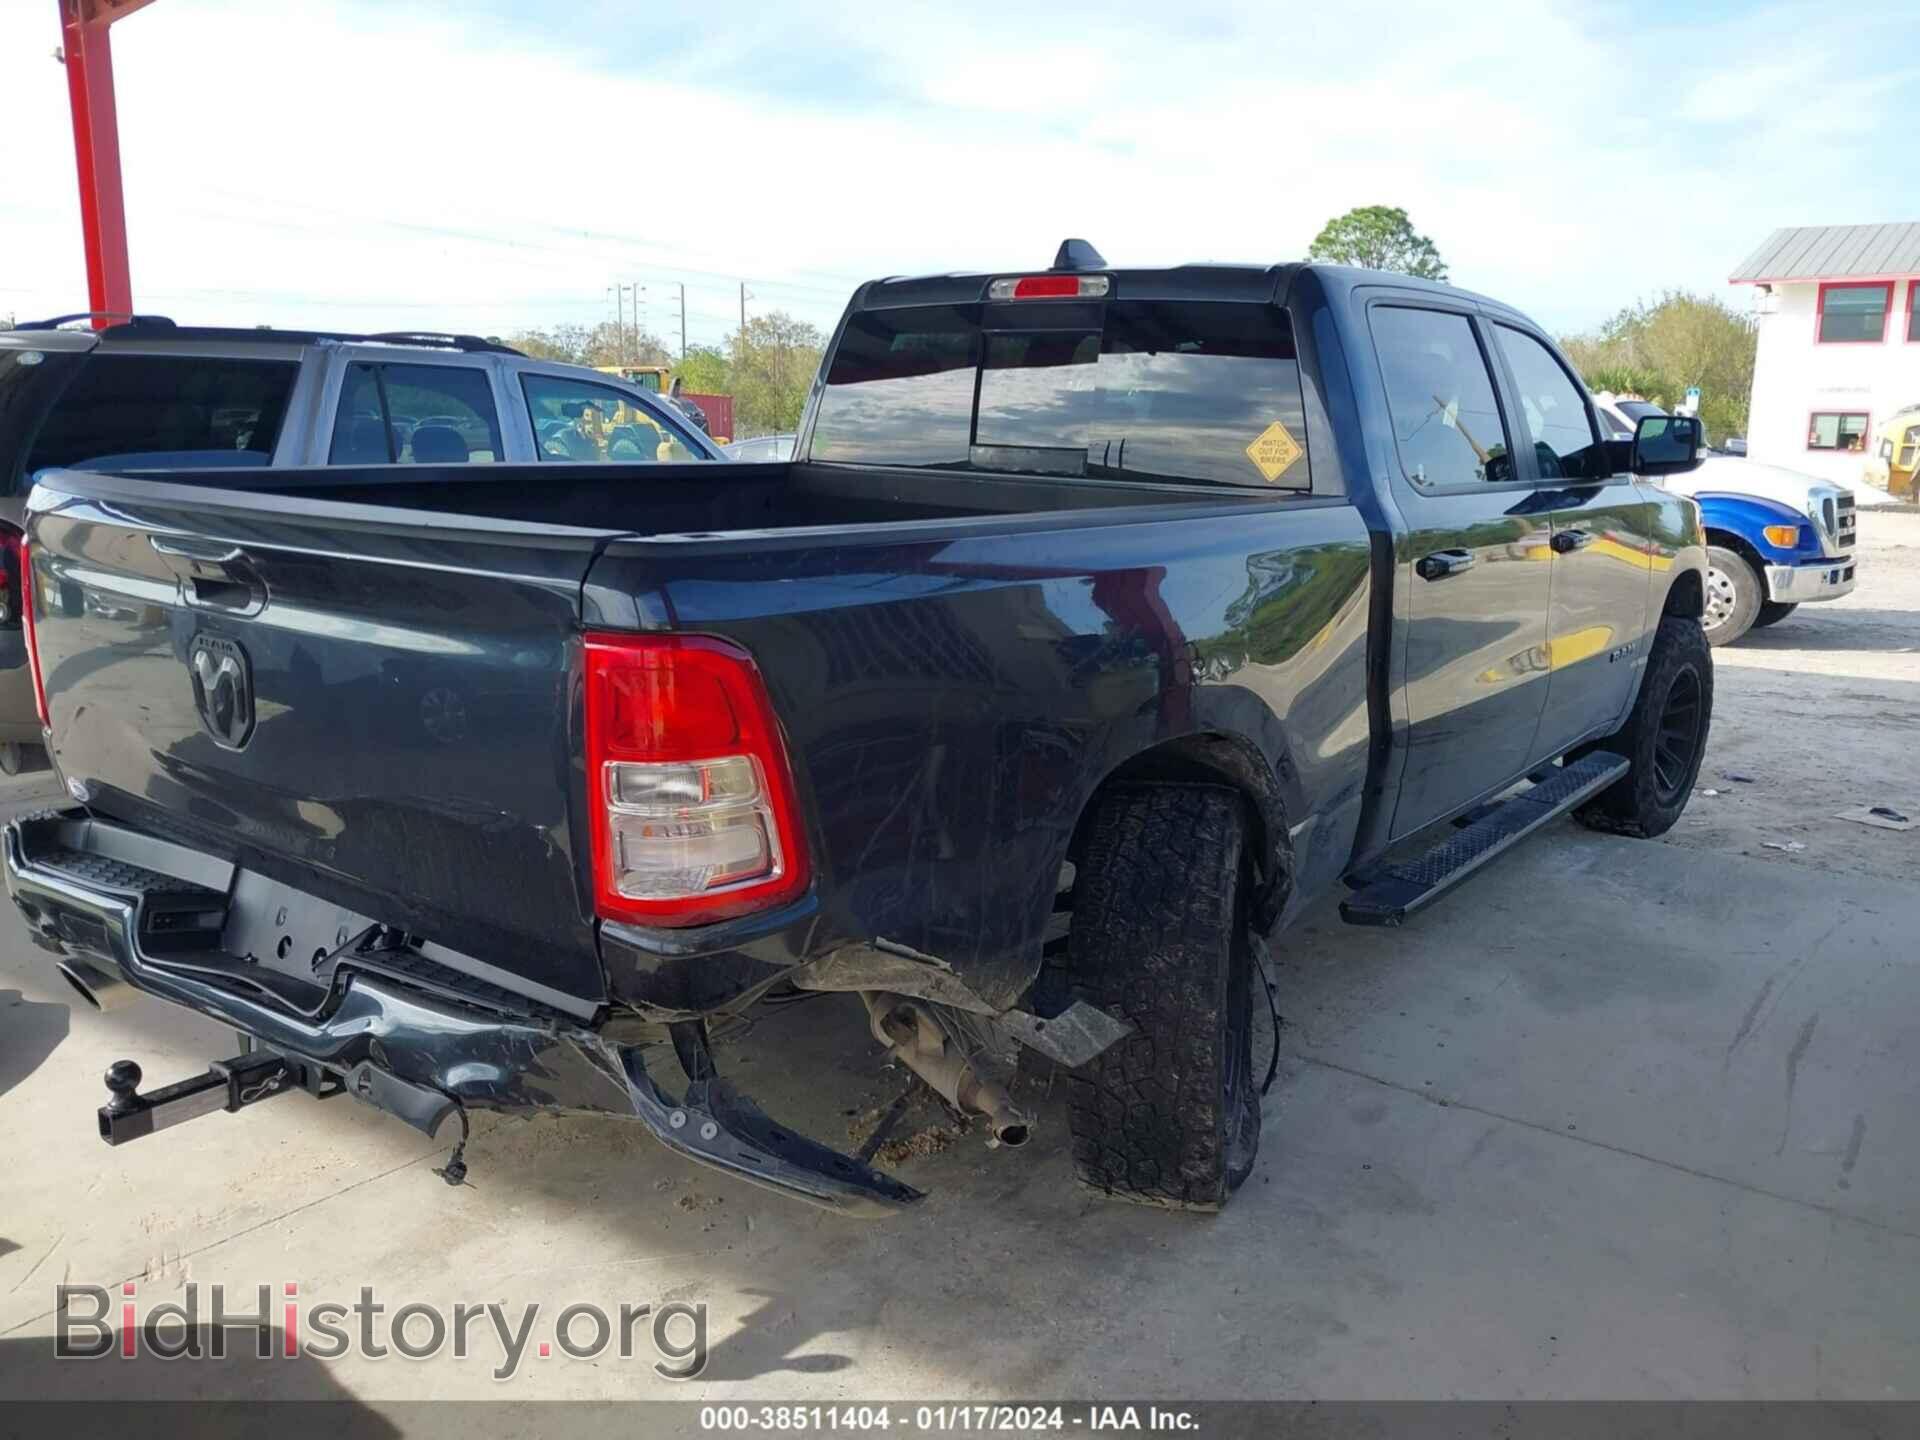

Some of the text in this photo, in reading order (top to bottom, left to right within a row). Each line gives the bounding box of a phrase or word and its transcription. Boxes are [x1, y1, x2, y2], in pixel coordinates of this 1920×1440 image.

[1261, 439, 1287, 448] WATCH
[1259, 447, 1289, 457] OUT FOR
